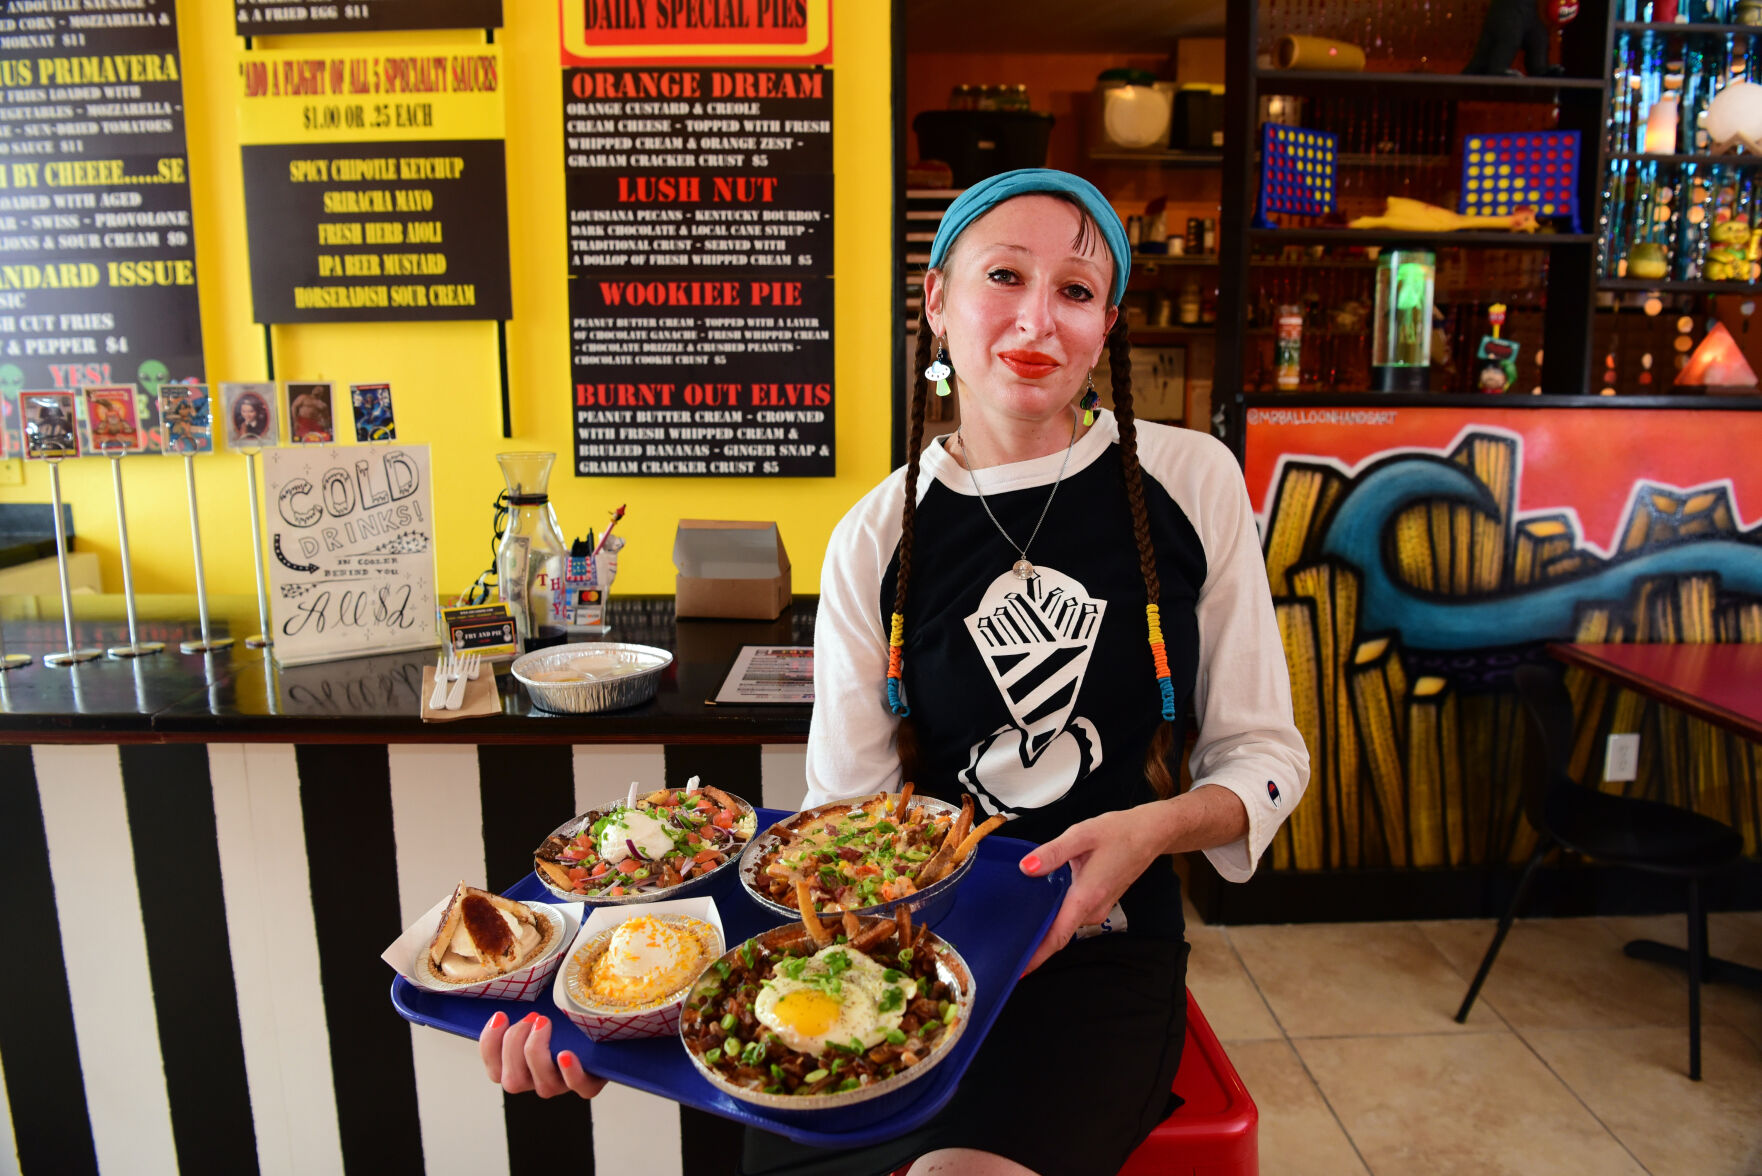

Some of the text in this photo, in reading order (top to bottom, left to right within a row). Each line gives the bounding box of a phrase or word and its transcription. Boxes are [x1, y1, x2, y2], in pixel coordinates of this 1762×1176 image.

[265, 5, 369, 22] FRIED EGG $11
[585, 0, 806, 29] DAILY SPECIAL PIES
[38, 54, 178, 85] PRIMAVERA
[384, 57, 447, 93] SPECIALTY
[452, 56, 497, 92] SAUCES
[50, 86, 141, 101] LOADED WITH
[572, 73, 823, 98] ORANGE DREAM
[86, 102, 172, 117] MOZZARELLA
[303, 104, 432, 129] $1.00 OR .25 EACH
[567, 103, 760, 115] ORANGE CUSTARD CREOLE
[102, 120, 173, 133] TOMATOES
[567, 120, 830, 133] CREAM CHEESE TOPPED WITH FRESH
[568, 138, 793, 150] WHIPPED CREAM ORANGE ZEST
[290, 157, 464, 182] SPICY CHIPOTLE KETCHUP
[568, 155, 768, 166] GRAHAM CRACKER CRUST $5
[13, 163, 39, 187] BY
[618, 177, 777, 202] LUSH NUT
[53, 192, 142, 209] WITH AGED
[324, 190, 433, 213] SRIRACHA MAYO
[32, 214, 80, 230] SWISS
[95, 211, 189, 228] PROVOLONE
[571, 211, 820, 221] LOUISIANA PECANS KENTUCKY BOURBON
[58, 231, 187, 249] SOUR CREAM $9
[318, 222, 442, 245] FRESH HERB AIOLI
[571, 226, 805, 236] DARK CHOCOLATE LOCAL CANE SYRUP
[572, 240, 785, 250] TRADITIONAL CRUST SERVED WITH
[319, 253, 446, 276] IPA BEER MUSTARD
[583, 255, 812, 265] DOLLOP OF FRESH WHIPPED CREAM $5
[108, 260, 194, 286] ISSUE
[295, 284, 475, 308] HORSERADISH SOUR CREAM
[600, 282, 802, 305] WOOKIEE PIE
[20, 315, 56, 332] CUT
[60, 313, 114, 331] FRIES
[574, 319, 819, 327] PEANUT BUTTER CREAM TOPPED WITH LAYER
[574, 331, 587, 339] OF
[589, 331, 647, 339] CHOCOLATE
[708, 331, 741, 339] FRESH
[745, 331, 791, 339] WHIPPED
[794, 331, 829, 339] CREAM
[25, 336, 128, 355] PEPPER $4
[582, 343, 793, 352] CHOCOLATE DRIZZLE CRUSHED PEANUTS
[575, 355, 726, 365] CHOCOLATE COOKIE CRUST $5
[50, 364, 111, 387] YES!
[576, 384, 831, 406] BURNT OUT ELVIS
[578, 411, 824, 423] PEANUT BUTTER CREAM CROWNED
[579, 428, 784, 440] WITH FRESH WHIPPED CREAM
[580, 445, 815, 457] BRULEED BANANAS GINGER SNAP
[580, 462, 779, 473] GRAHAM CRACKER CRUST $5
[278, 451, 419, 528] COLD
[299, 501, 423, 559] DRINKS!
